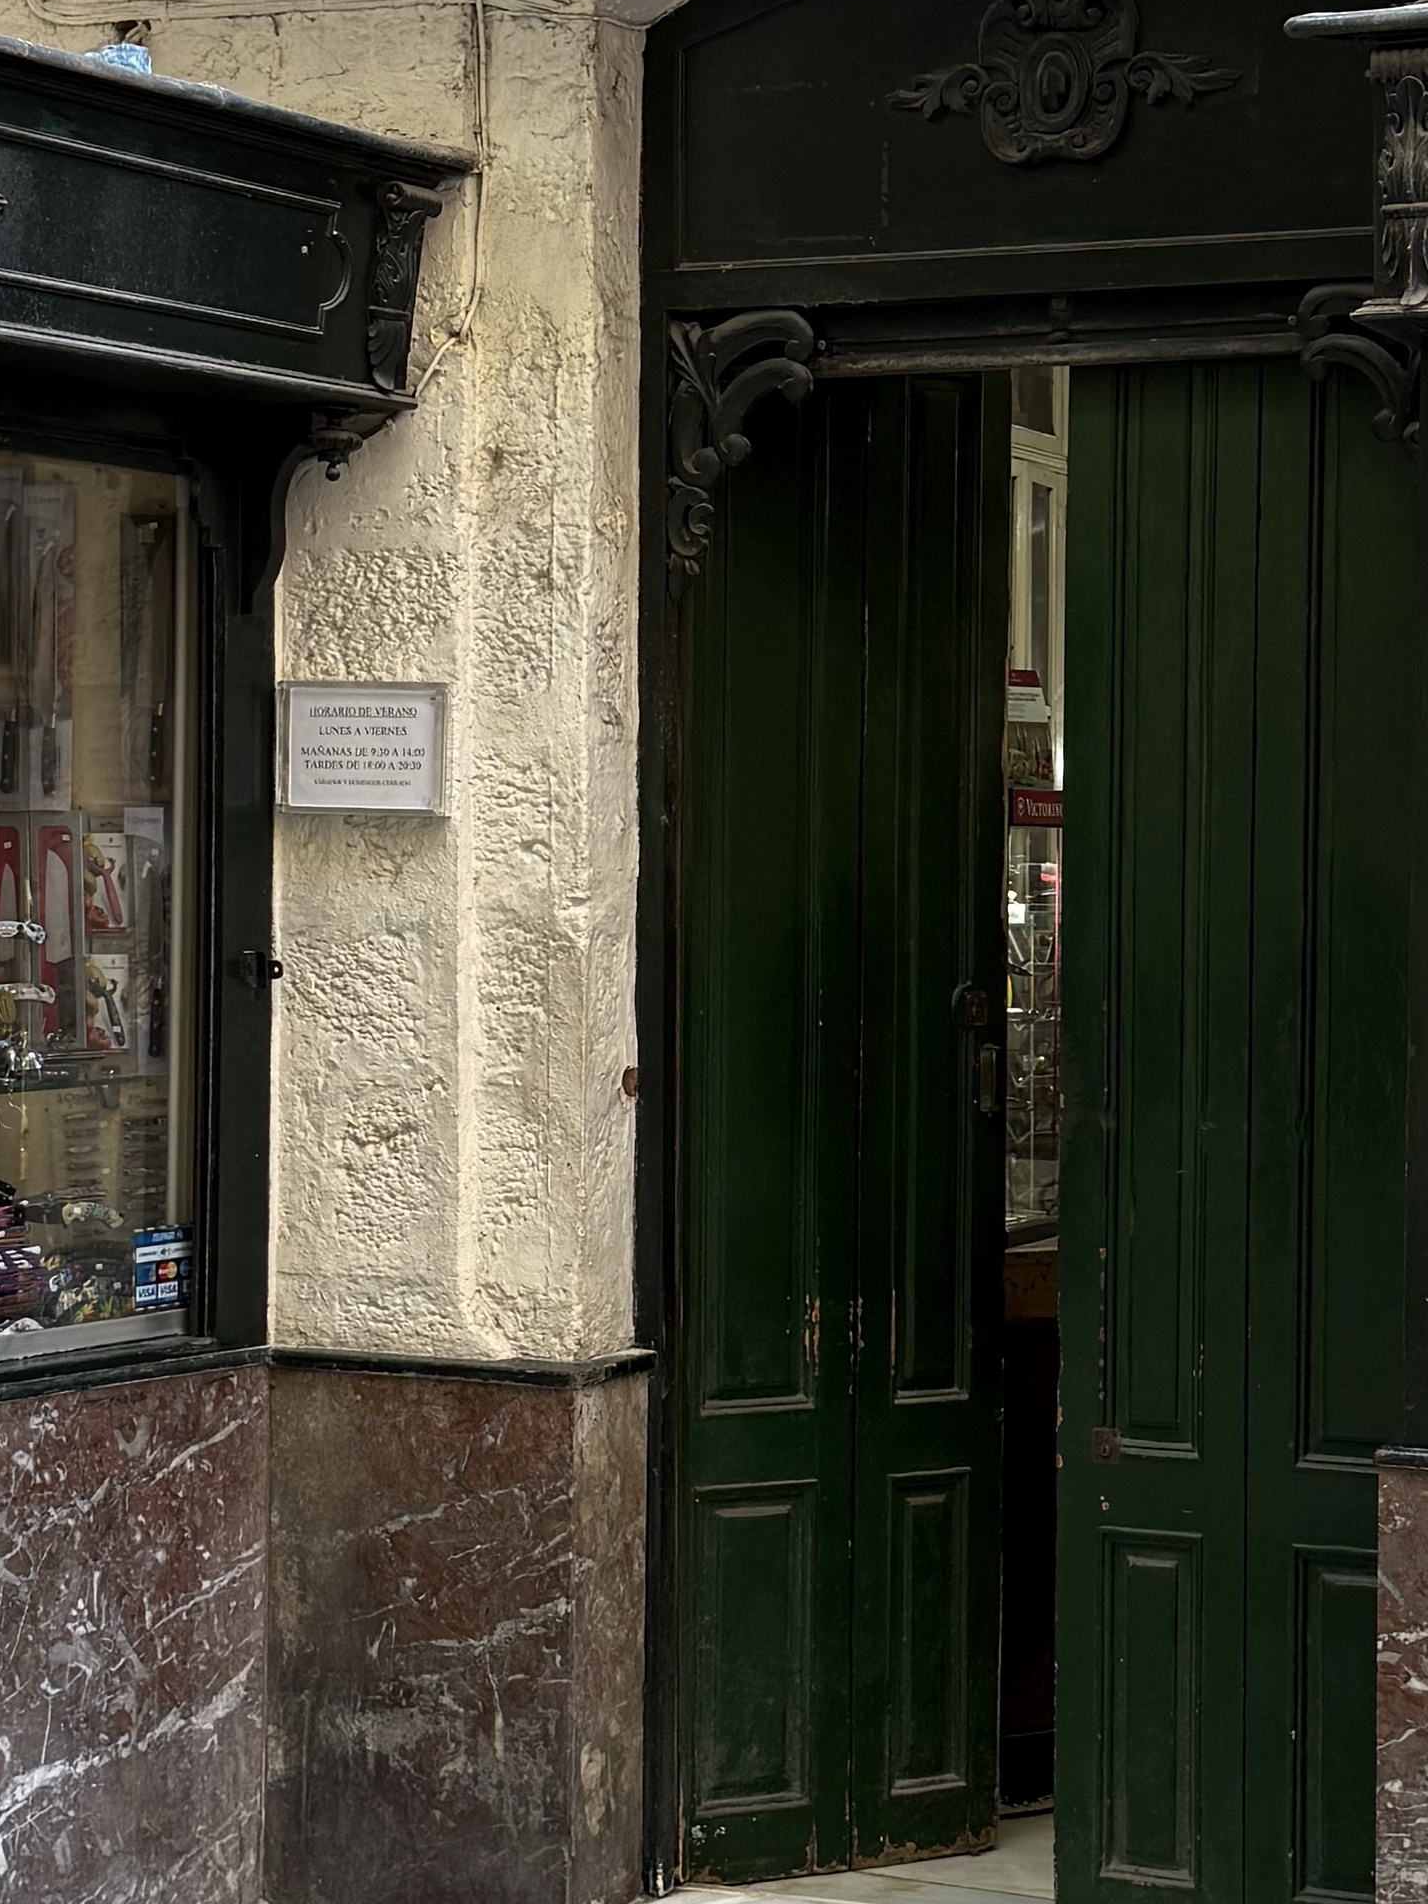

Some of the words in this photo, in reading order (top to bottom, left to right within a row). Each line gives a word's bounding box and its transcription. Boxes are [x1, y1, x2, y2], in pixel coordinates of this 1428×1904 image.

[310, 707, 356, 718] HORARIO
[358, 707, 371, 718] DE
[375, 707, 418, 718] VERANO
[319, 726, 352, 736] LUNES
[354, 727, 362, 736] A
[364, 726, 408, 736] VIERNES
[301, 745, 352, 757] MAÑANAS
[355, 748, 368, 757] DE
[391, 748, 399, 757] A
[304, 760, 344, 770] TARDES
[346, 760, 360, 770] DE
[388, 761, 396, 770] A
